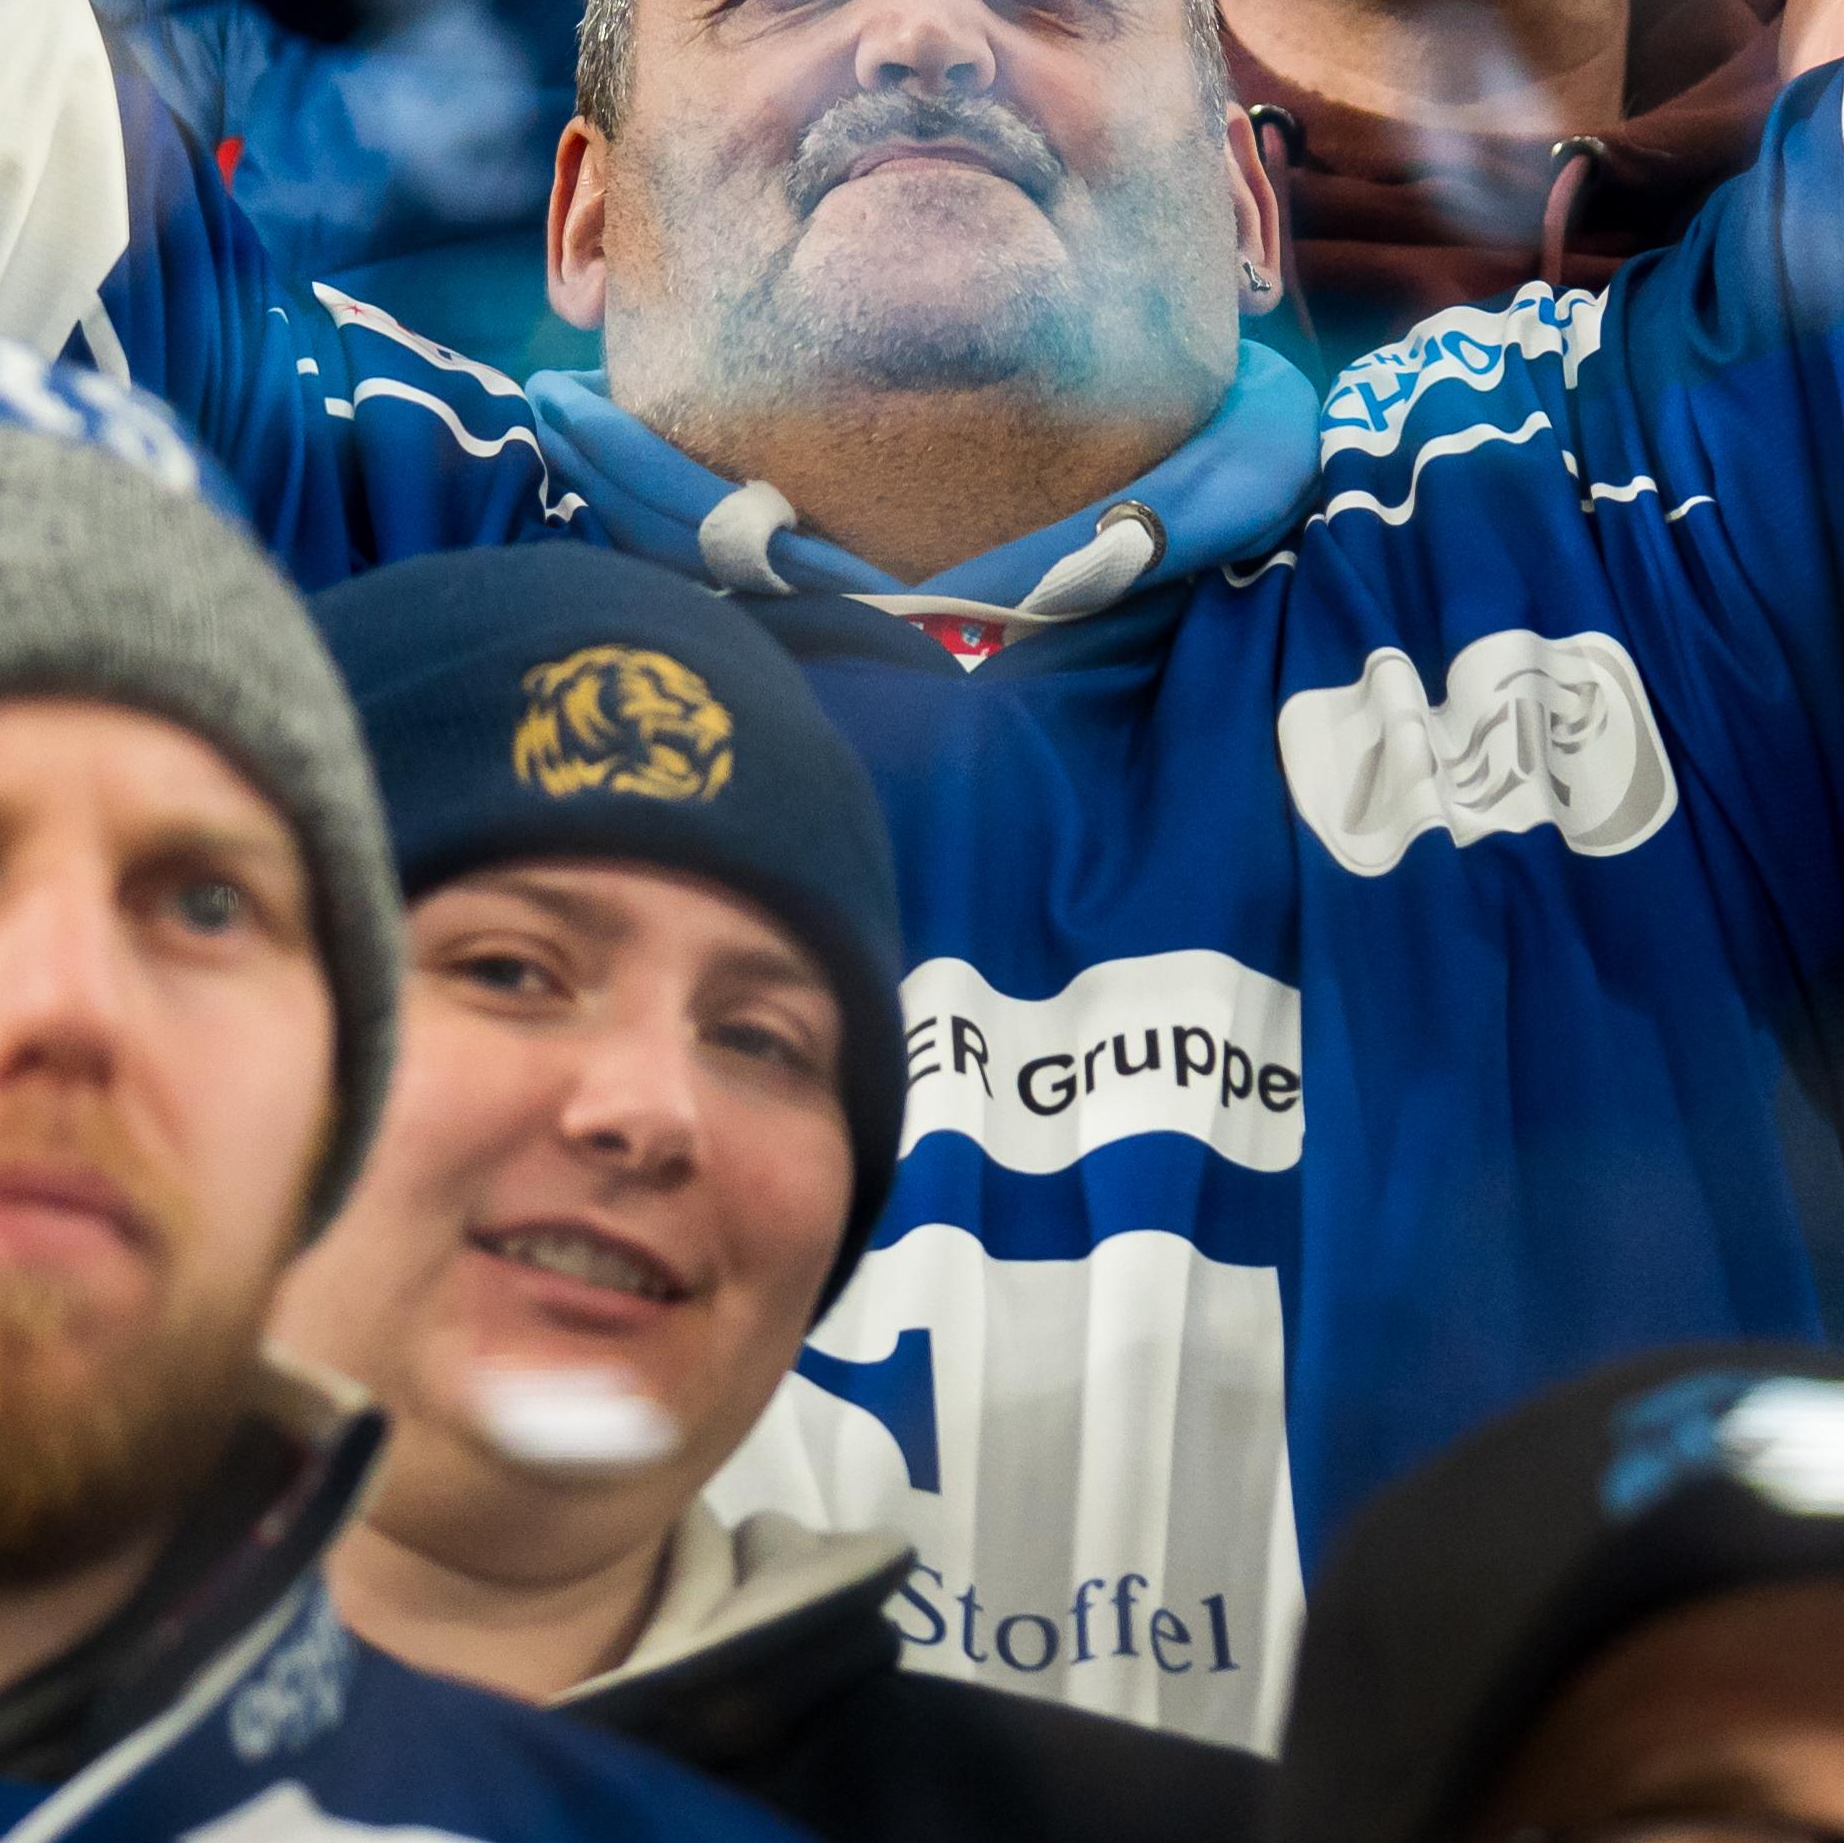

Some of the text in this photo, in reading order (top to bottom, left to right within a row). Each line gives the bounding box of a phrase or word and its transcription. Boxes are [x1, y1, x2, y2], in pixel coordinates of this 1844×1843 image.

[904, 1014, 1300, 1117] ER Gruppe
[895, 1561, 1241, 1674] Stoffel
